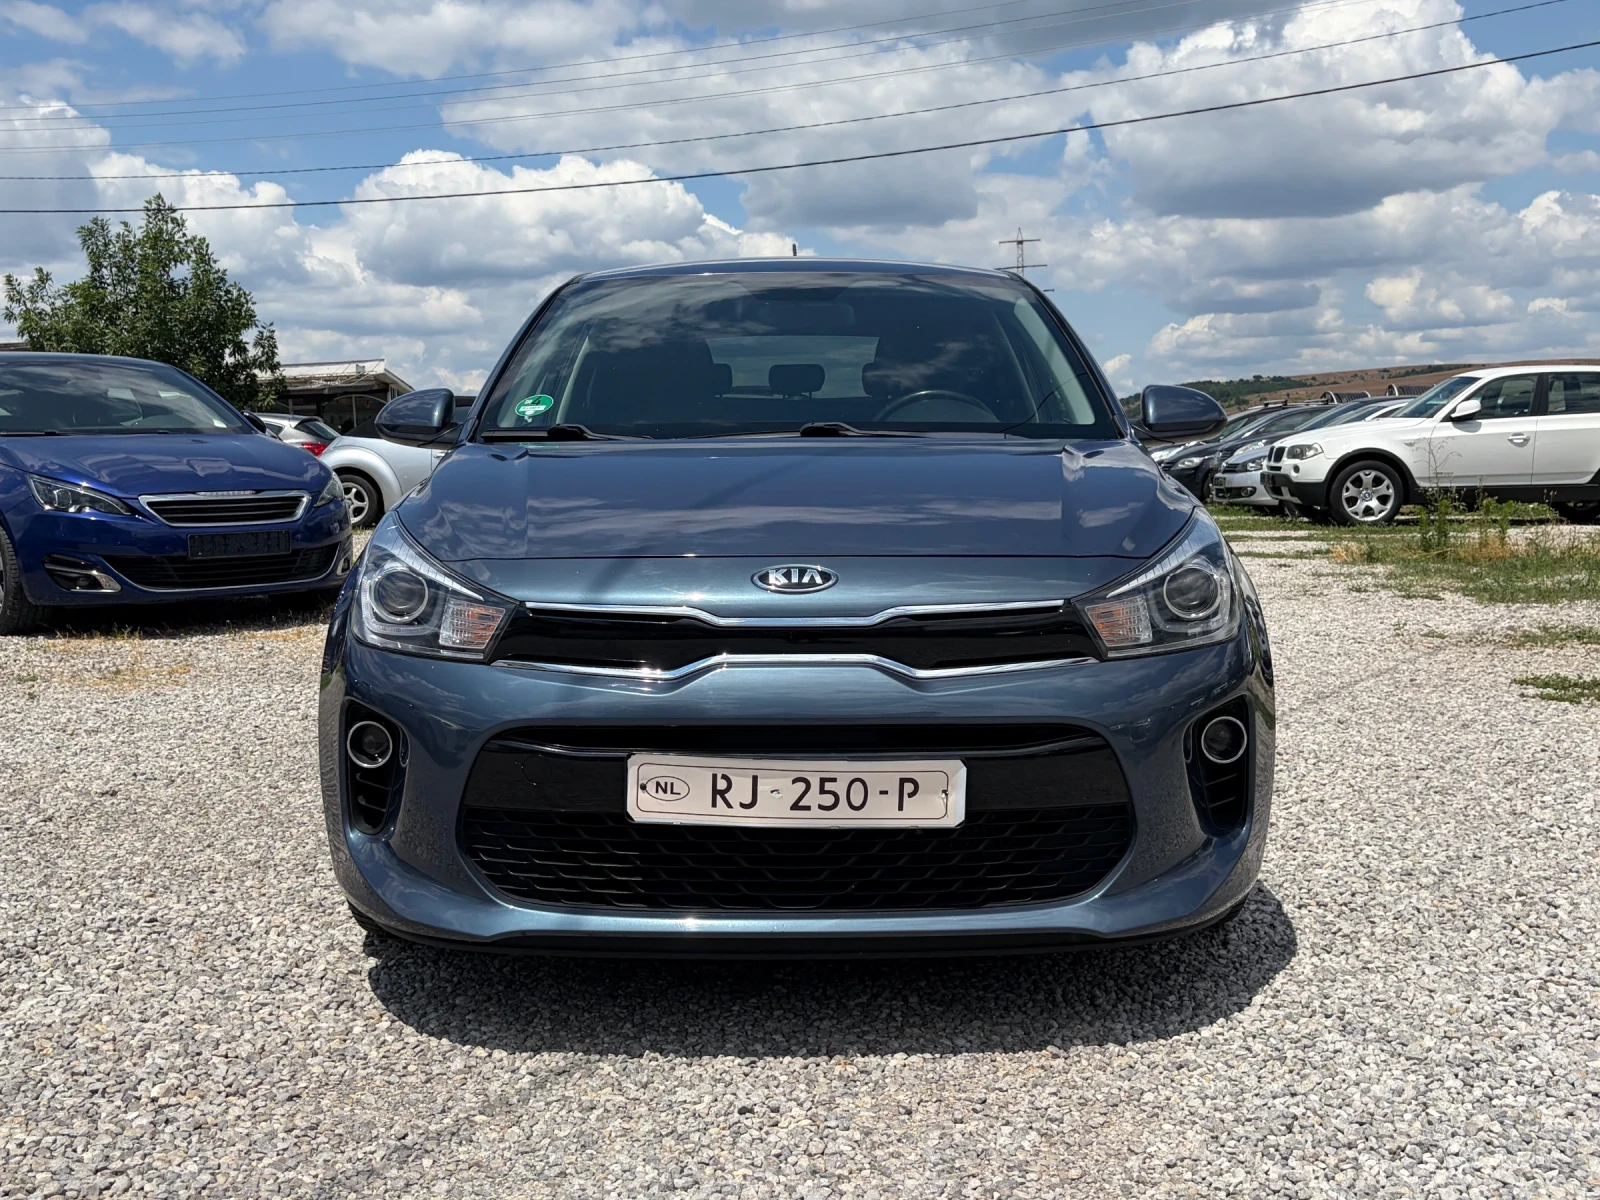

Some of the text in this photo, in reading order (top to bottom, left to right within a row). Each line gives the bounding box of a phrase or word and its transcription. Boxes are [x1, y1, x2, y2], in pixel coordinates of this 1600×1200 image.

[531, 396, 542, 405] 4
[768, 568, 823, 585] KIA
[655, 781, 681, 795] NL
